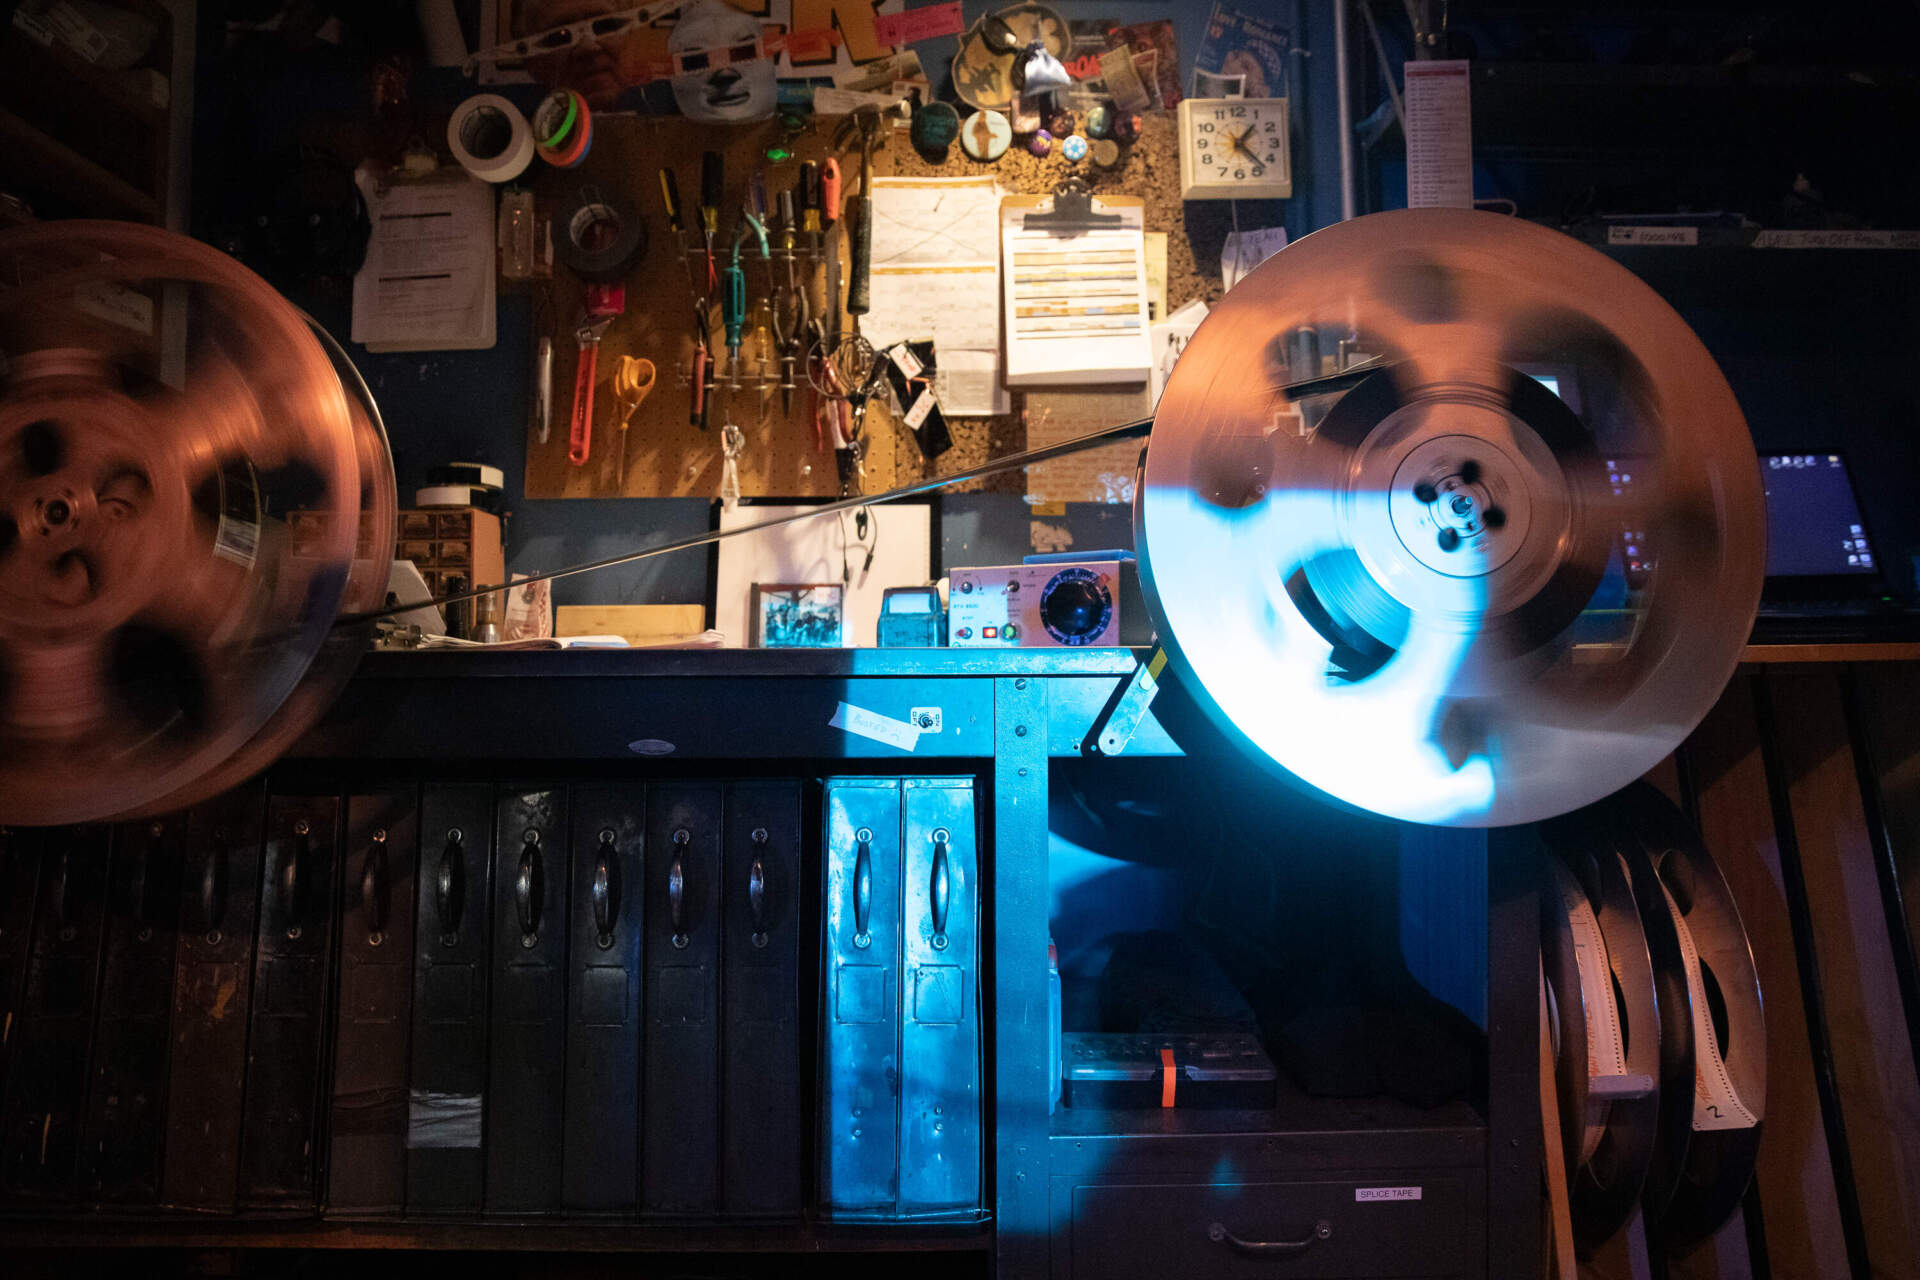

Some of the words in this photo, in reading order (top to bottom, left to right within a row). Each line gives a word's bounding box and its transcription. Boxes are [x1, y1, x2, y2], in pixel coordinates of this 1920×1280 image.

[1214, 110, 1225, 120] 11
[1229, 106, 1247, 118] 12
[1253, 109, 1259, 119] 1
[1198, 123, 1215, 133] 10
[1265, 122, 1276, 133] 2
[1197, 138, 1208, 149] 9
[1269, 138, 1280, 149] 3
[1202, 154, 1213, 165] 8
[1265, 153, 1276, 163] 4
[1217, 167, 1228, 177] 7
[1234, 168, 1245, 179] 6
[1705, 1105, 1726, 1120] 2
[1360, 1190, 1390, 1199] SPLICE
[1393, 1189, 1413, 1198] TAPE
